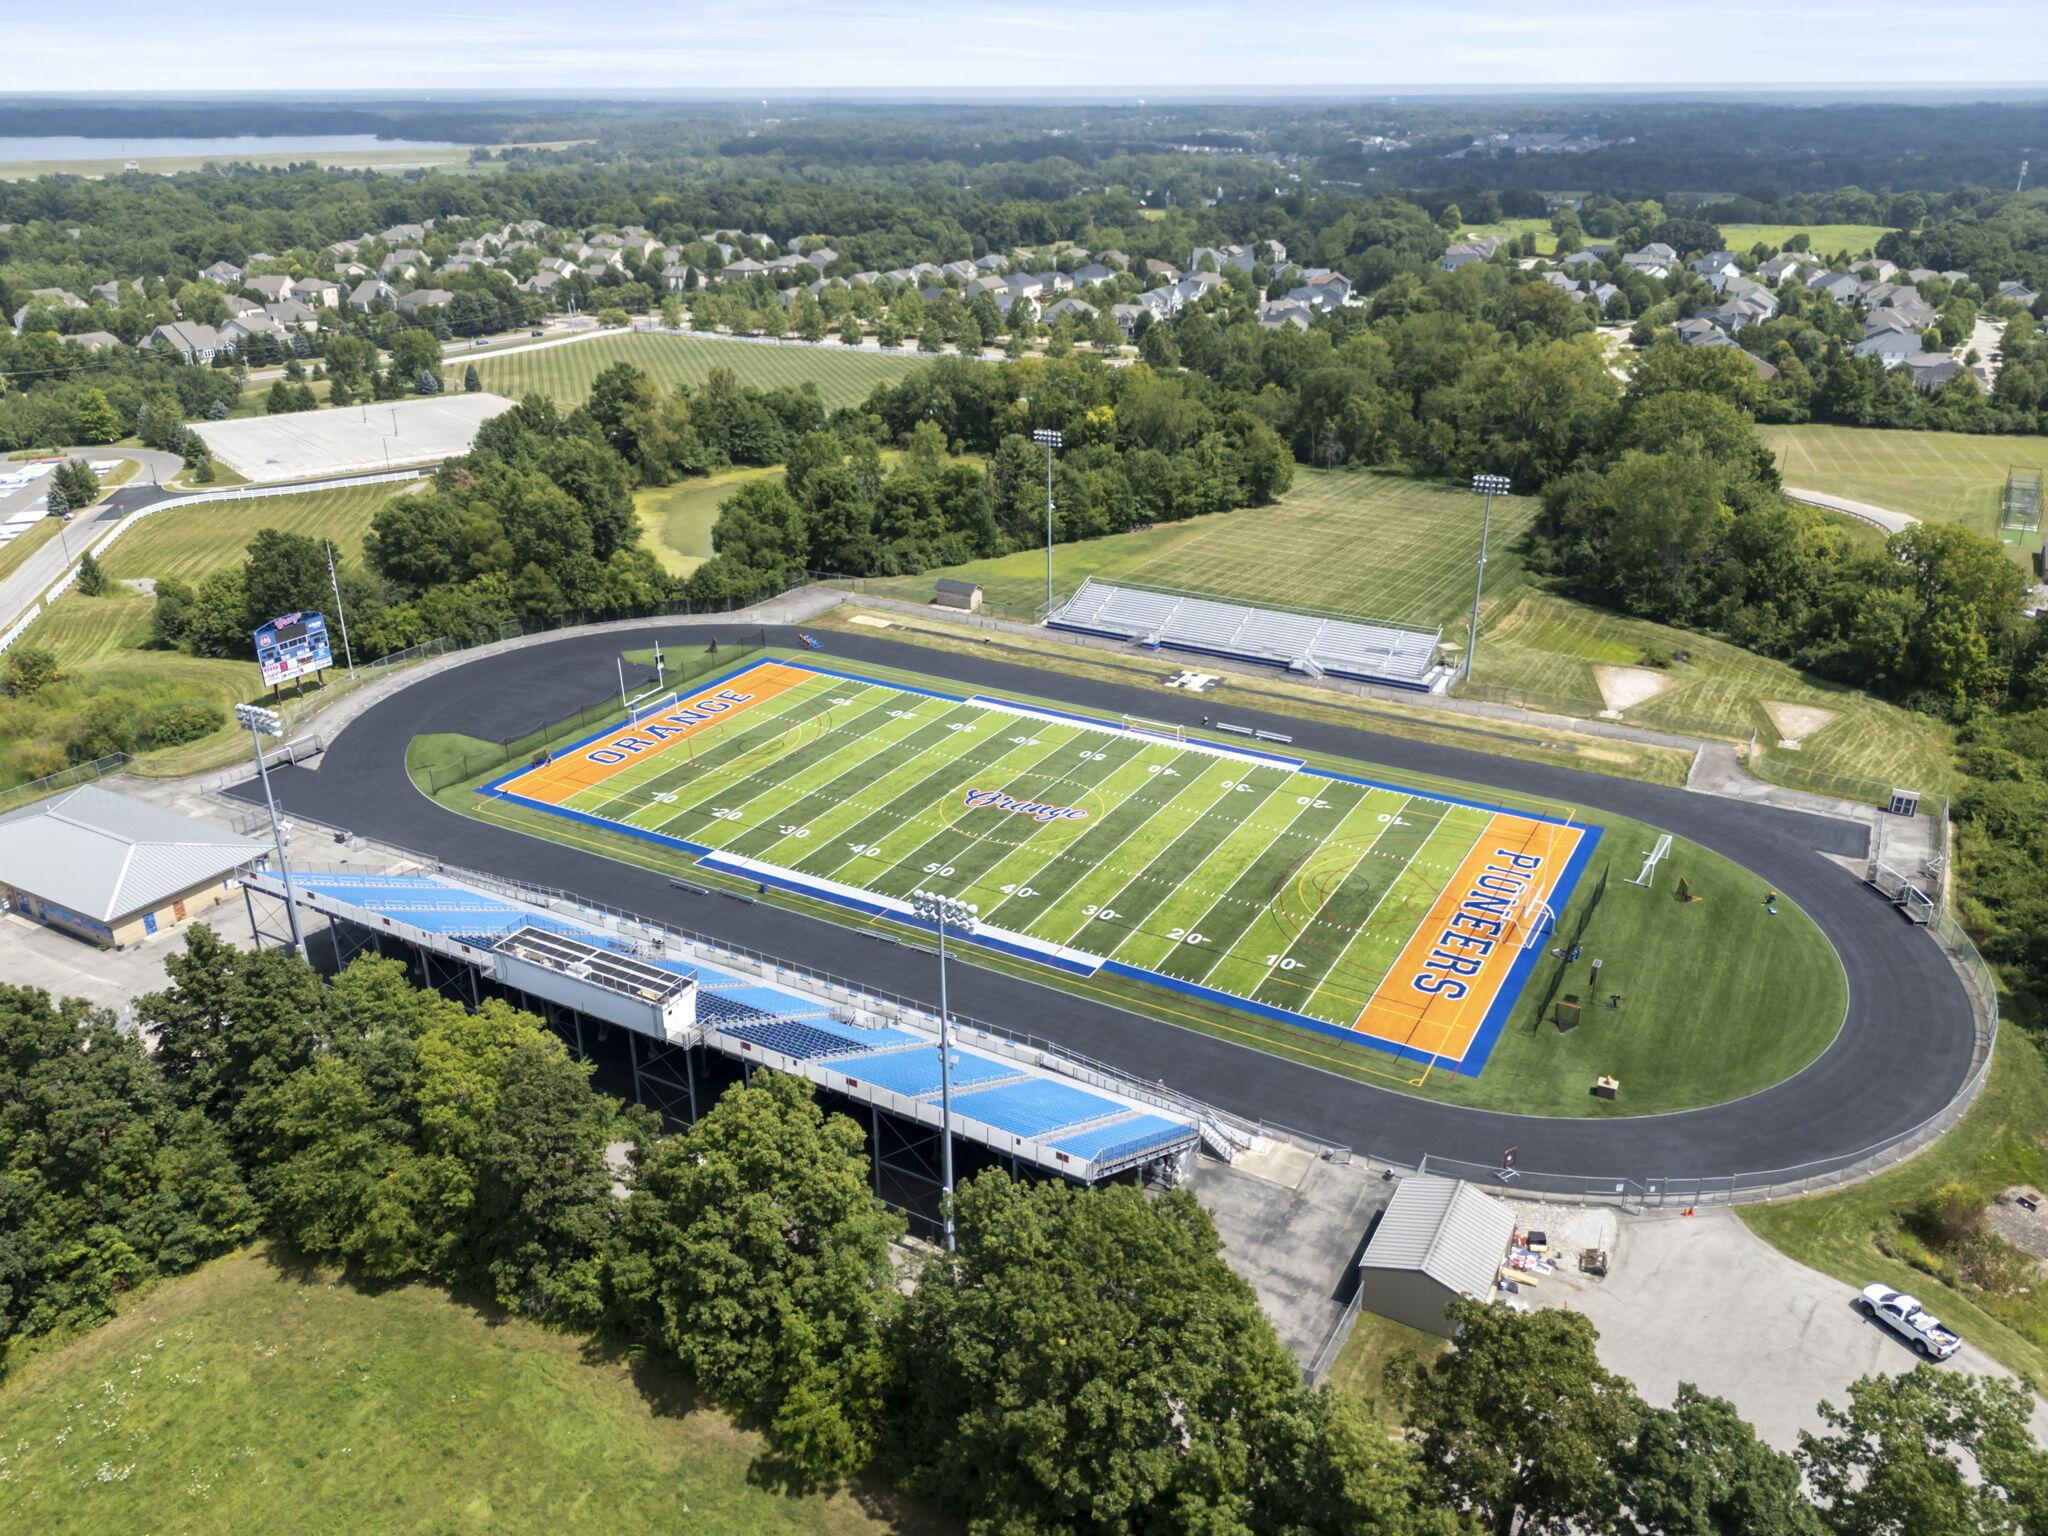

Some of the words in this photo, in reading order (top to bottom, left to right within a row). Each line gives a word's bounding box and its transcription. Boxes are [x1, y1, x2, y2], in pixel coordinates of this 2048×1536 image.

[891, 710, 917, 720] 20
[586, 690, 755, 765] ORANGE
[1079, 750, 1106, 761] 50
[1147, 765, 1176, 776] 40
[1220, 780, 1250, 793] 30
[654, 791, 679, 803] 10
[1296, 796, 1328, 809] 20
[965, 788, 1088, 822] Orange
[714, 808, 743, 820] 20
[1377, 813, 1407, 826] 10
[780, 825, 811, 838] 30
[849, 842, 881, 857] 40
[923, 863, 955, 877] 50
[1000, 883, 1034, 898] 40
[1081, 905, 1116, 920] 30
[1412, 848, 1543, 1000] PIONEERS
[1166, 928, 1203, 945] 20
[1266, 954, 1302, 970] 10
